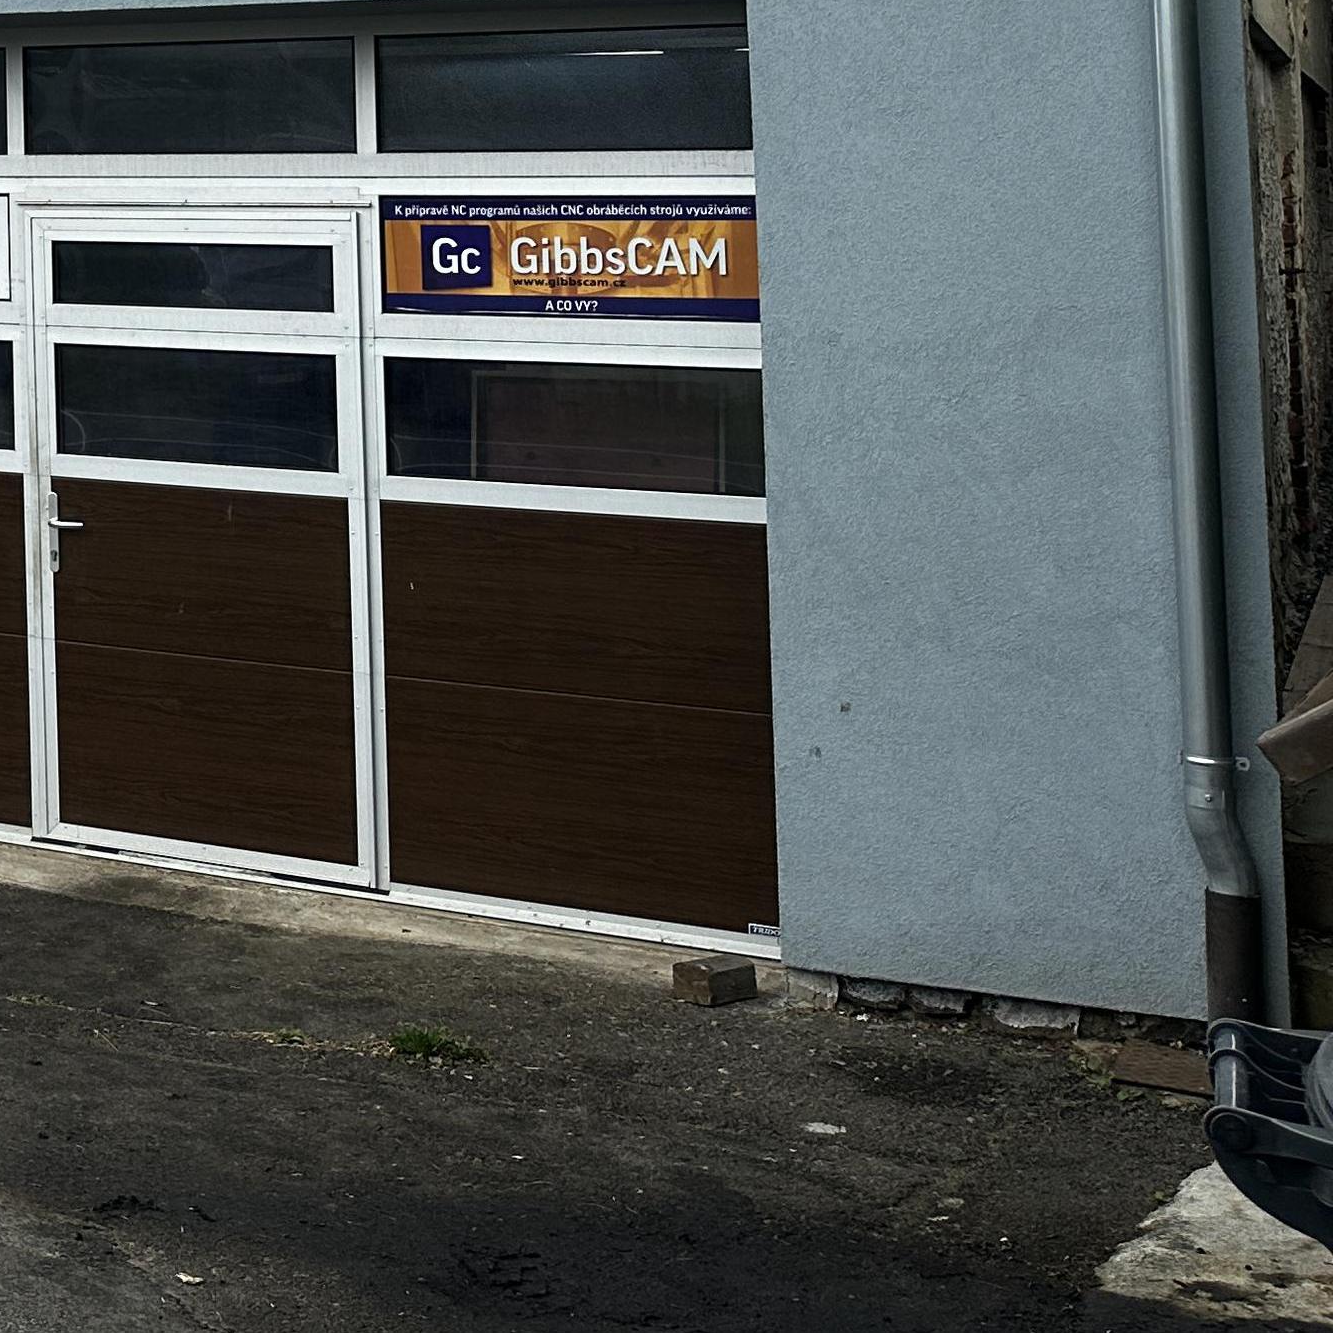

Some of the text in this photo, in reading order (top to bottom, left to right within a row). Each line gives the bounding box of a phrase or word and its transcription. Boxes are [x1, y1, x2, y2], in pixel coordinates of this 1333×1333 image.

[394, 204, 403, 216] K
[451, 204, 467, 216] NC
[469, 204, 521, 218] programů
[523, 204, 558, 216] našich
[560, 204, 584, 216] CNC
[586, 204, 647, 216] obráběcích
[649, 204, 683, 217] strojů
[432, 236, 482, 275] Gc
[510, 235, 728, 277] GibbsCAM
[512, 276, 627, 288] www.gibbscam.cz
[545, 300, 598, 312] A CO VY?
